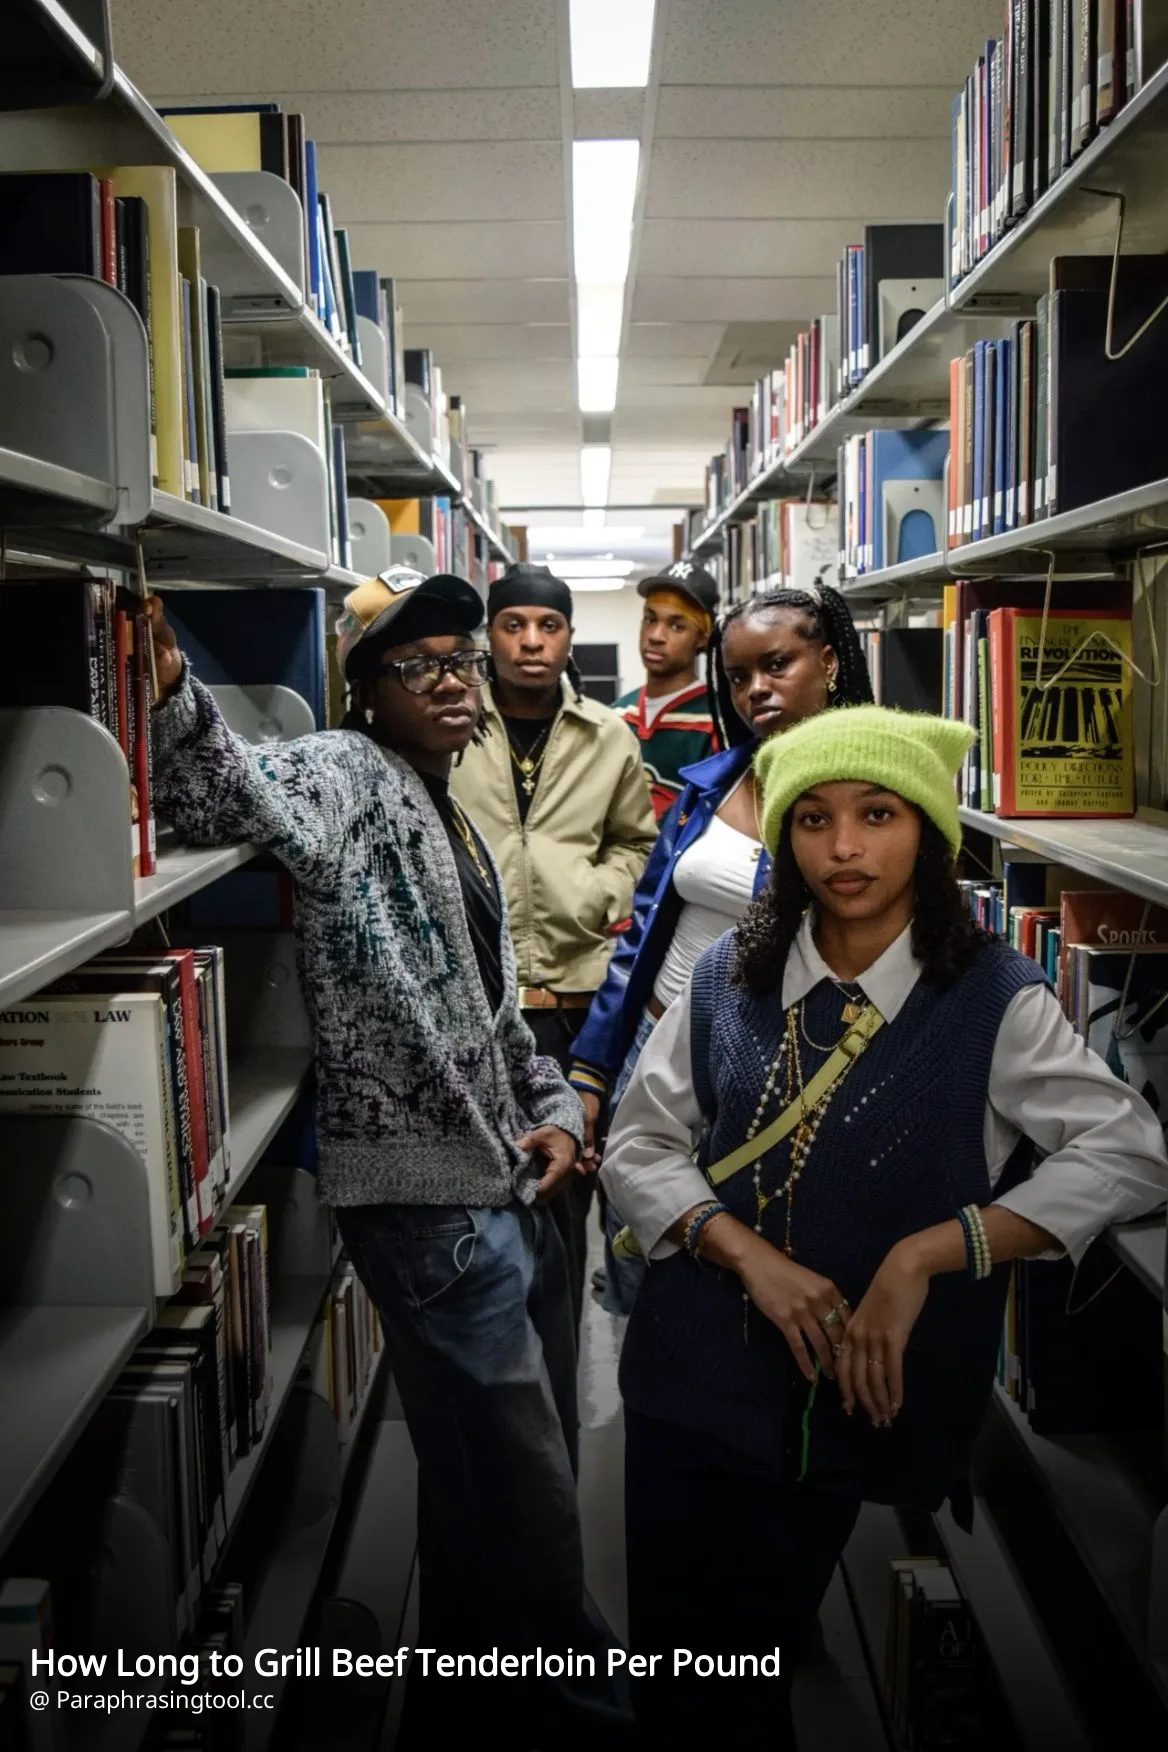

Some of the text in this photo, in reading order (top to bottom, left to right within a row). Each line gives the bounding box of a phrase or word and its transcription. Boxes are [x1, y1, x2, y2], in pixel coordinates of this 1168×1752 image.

[1020, 647, 1122, 661] REVOLUTION
[0, 1011, 49, 1023] ATION
[94, 1010, 131, 1023] LAW
[176, 1048, 185, 1087] AND
[17, 1072, 68, 1081] Textbook
[56, 1087, 102, 1096] Students
